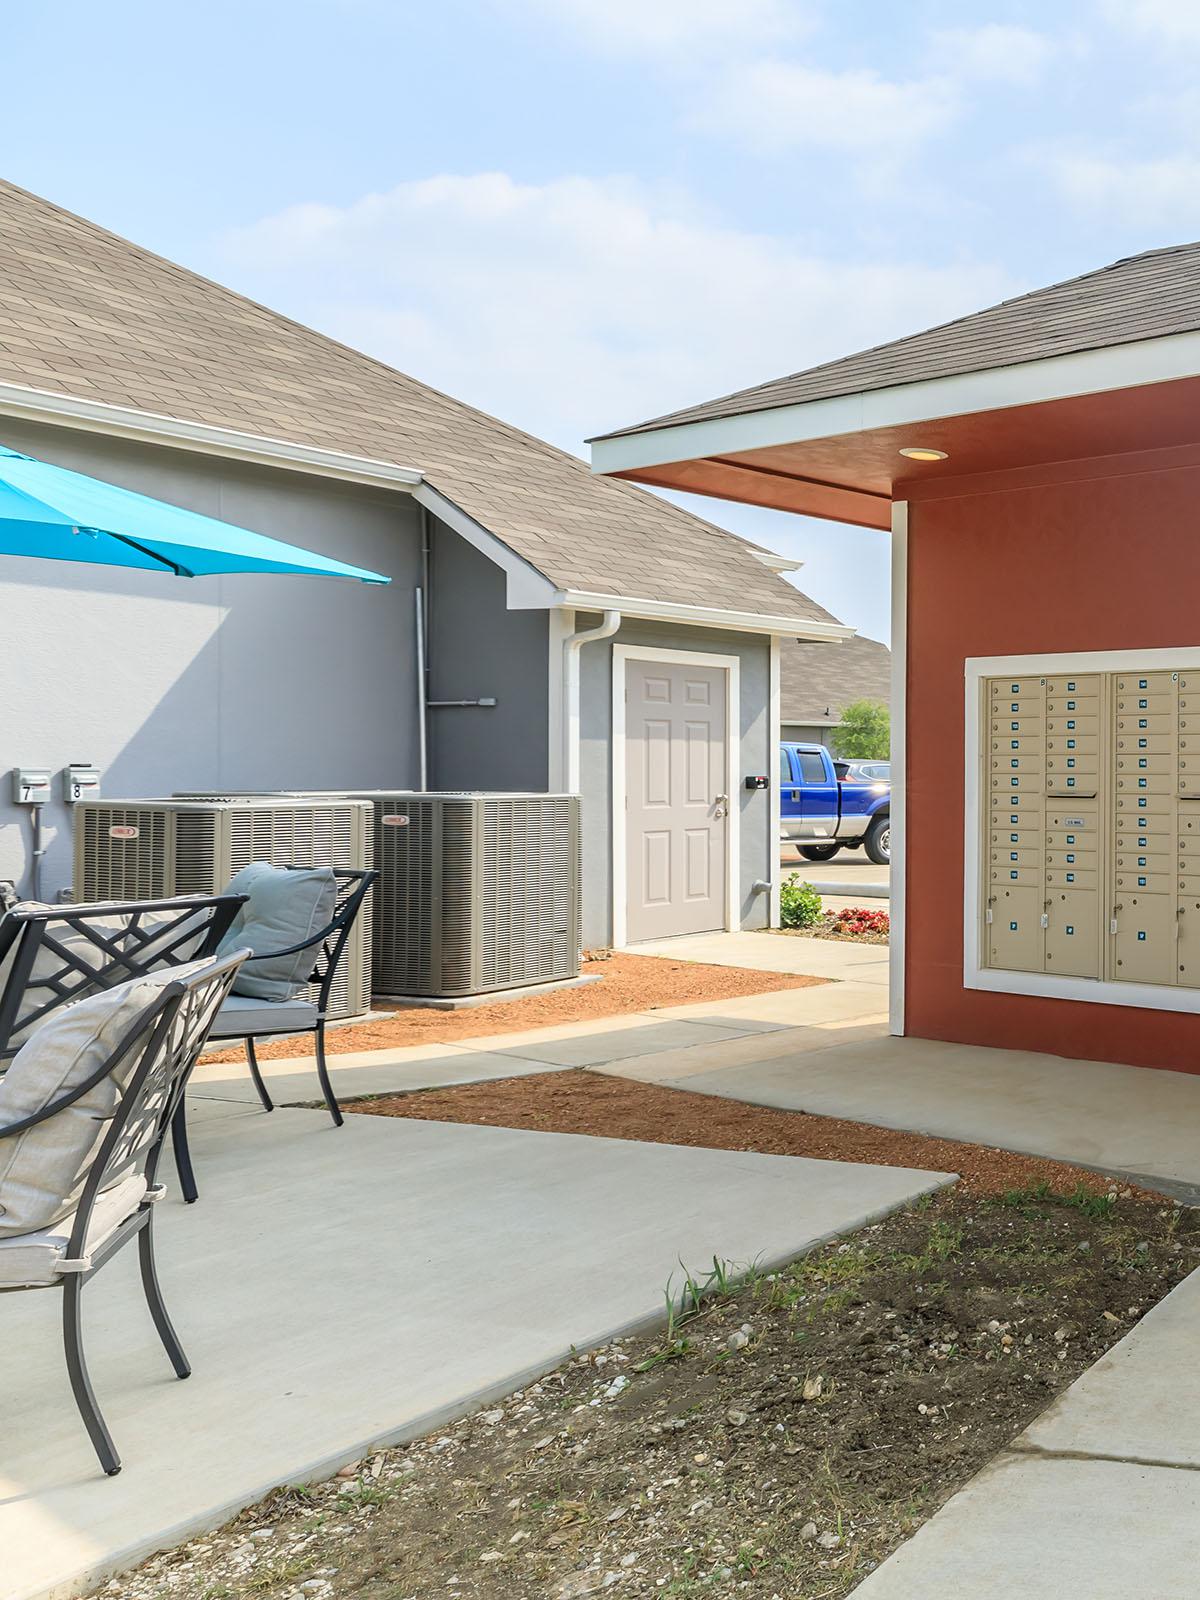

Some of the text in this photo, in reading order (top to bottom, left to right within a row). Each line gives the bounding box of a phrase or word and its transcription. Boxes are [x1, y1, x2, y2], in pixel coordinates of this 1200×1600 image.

[1172, 673, 1178, 681] C
[22, 786, 31, 800] 7
[73, 784, 81, 798] 8
